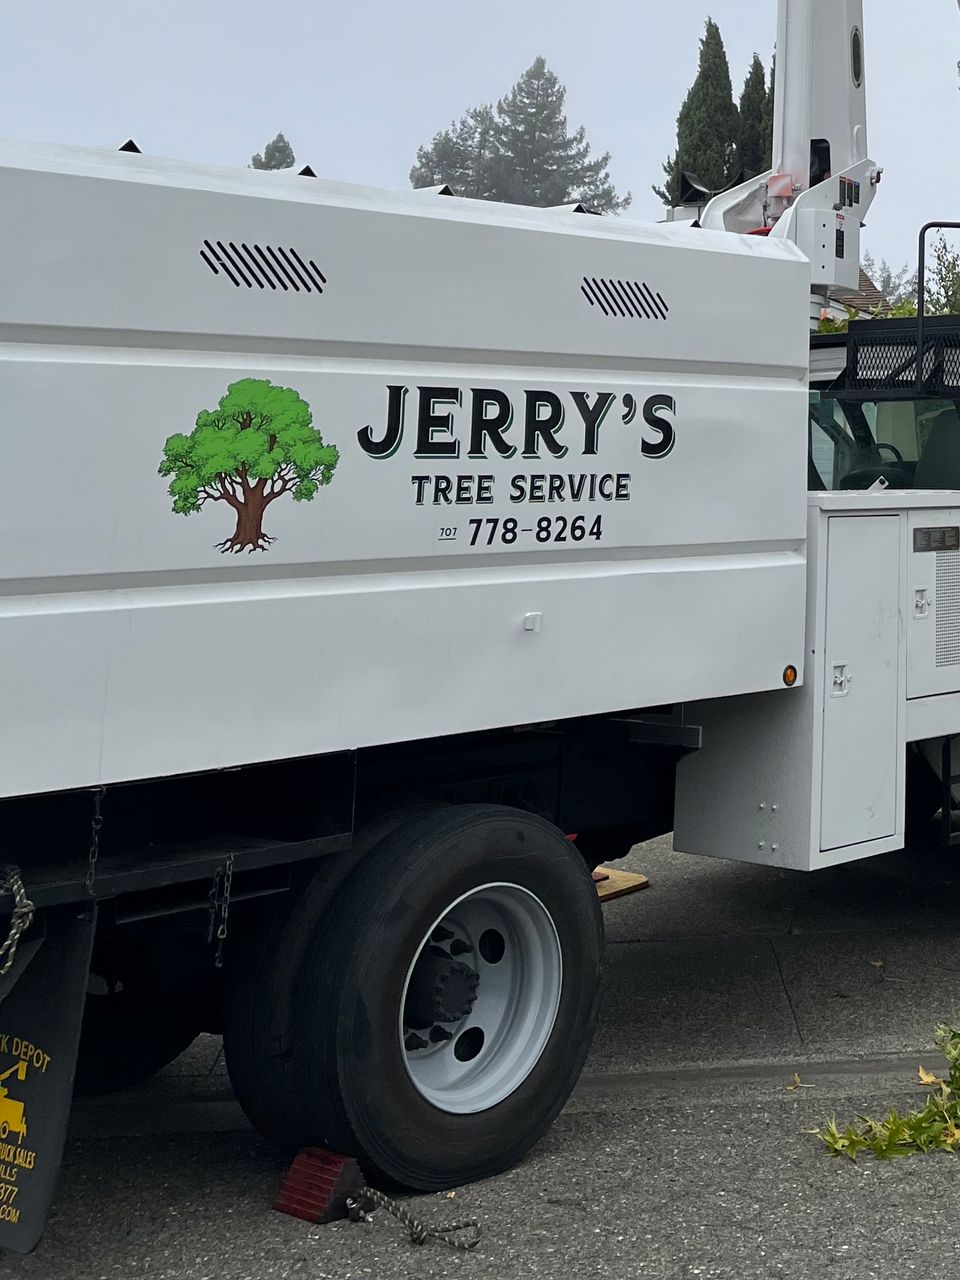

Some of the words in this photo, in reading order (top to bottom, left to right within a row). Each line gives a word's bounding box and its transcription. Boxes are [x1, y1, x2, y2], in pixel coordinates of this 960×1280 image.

[357, 384, 676, 460] JERRY'S
[411, 474, 495, 506] TREE
[509, 473, 631, 503] SERVICE
[439, 527, 457, 538] 707
[468, 515, 602, 546] 778-8264
[0, 1033, 10, 1053] K
[12, 1037, 51, 1073] DEPOT
[14, 1146, 37, 1170] SALES
